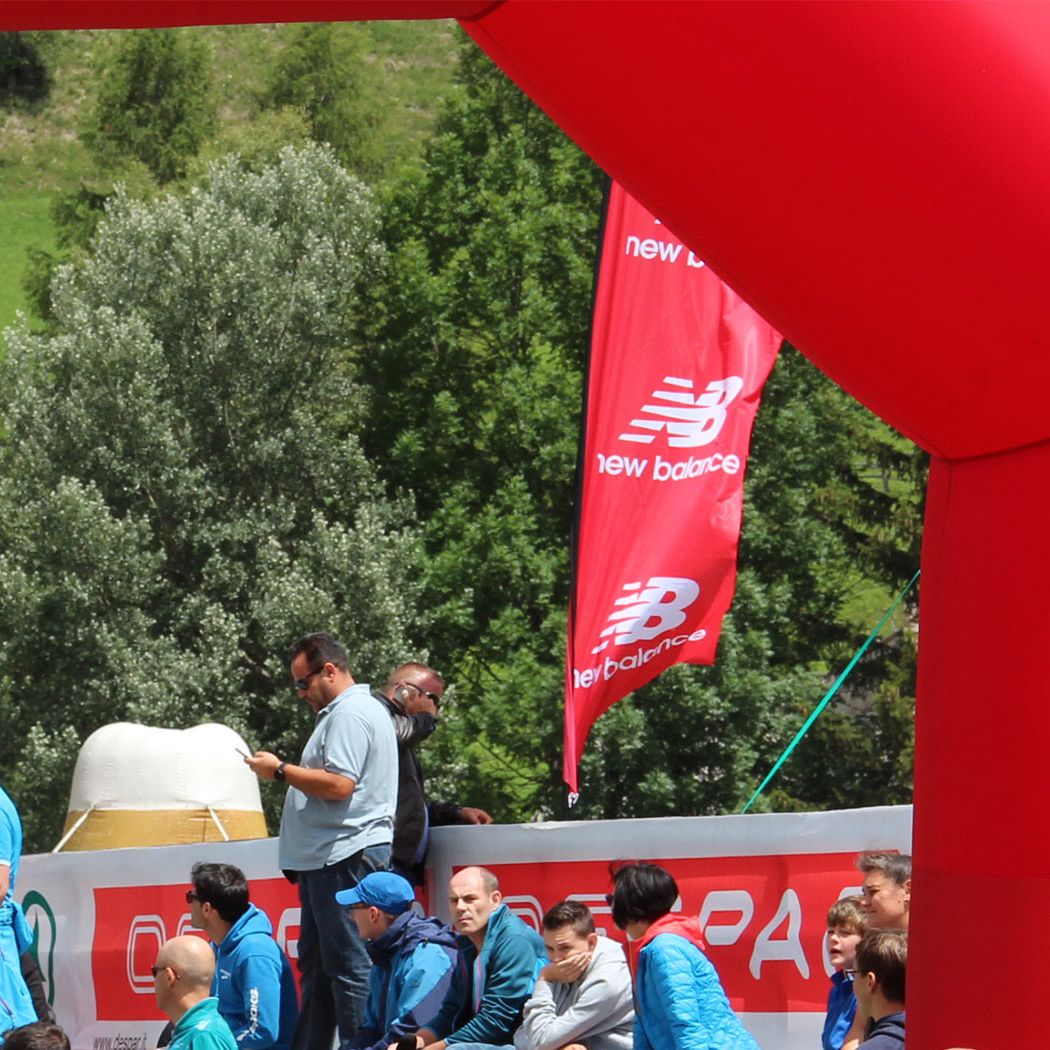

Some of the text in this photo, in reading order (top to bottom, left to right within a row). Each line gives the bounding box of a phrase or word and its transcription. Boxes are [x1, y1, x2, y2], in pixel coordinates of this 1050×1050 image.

[625, 235, 684, 263] new
[652, 452, 741, 481] balance
[603, 629, 707, 681] balance
